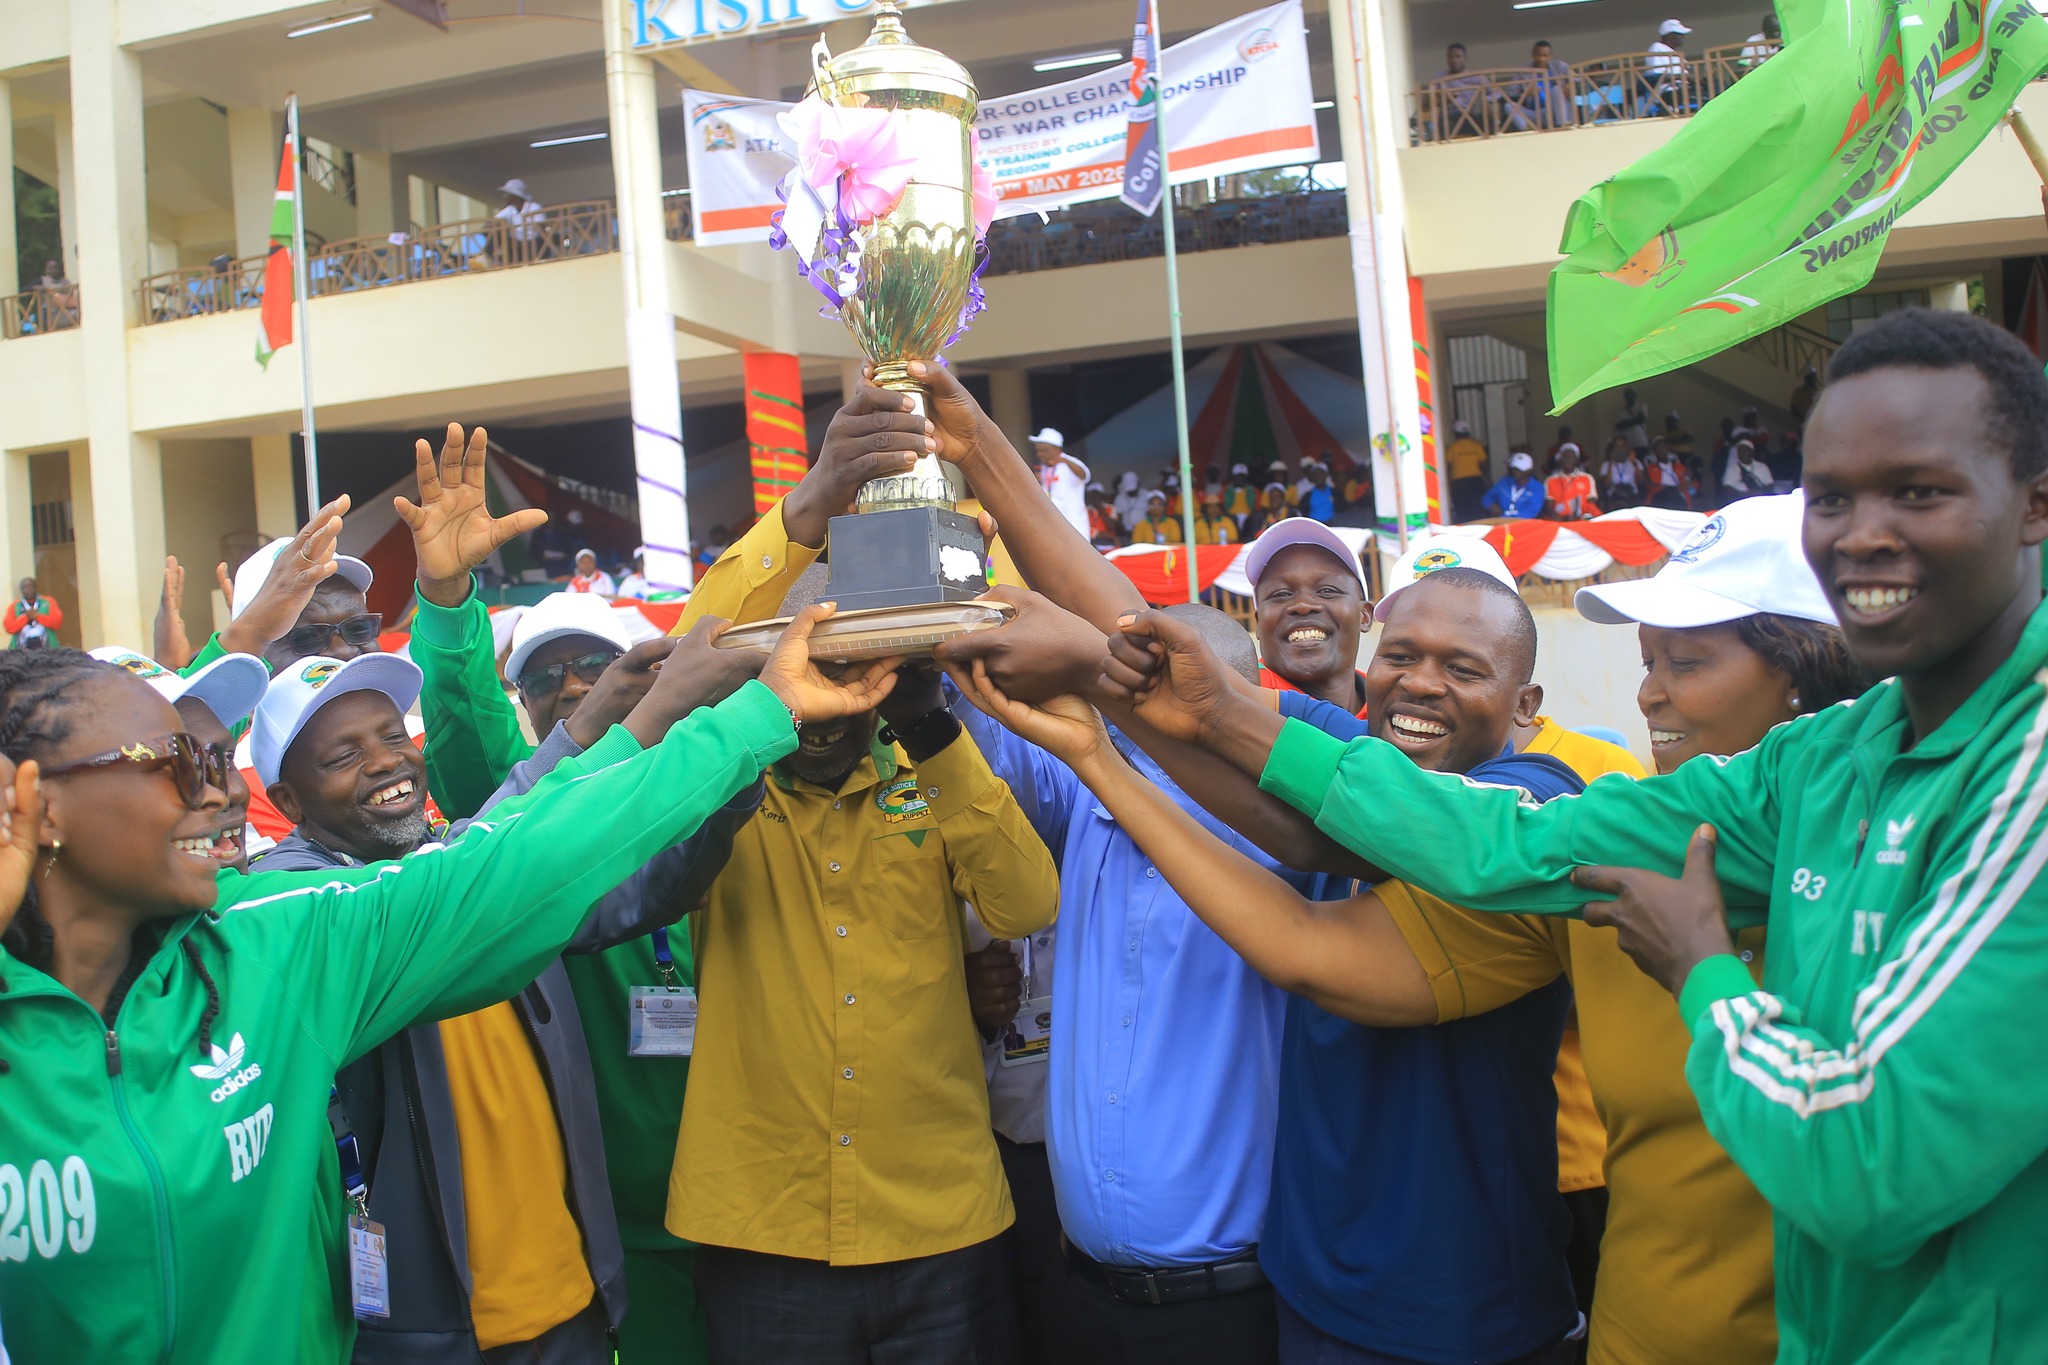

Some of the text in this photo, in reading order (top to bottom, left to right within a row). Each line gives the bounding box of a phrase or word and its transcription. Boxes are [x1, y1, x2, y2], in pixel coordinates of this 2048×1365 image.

[976, 79, 1131, 122] R-COLLEGIAT
[978, 125, 1007, 140] OF
[1014, 115, 1065, 135] WAR
[994, 147, 1062, 166] TRAINING
[996, 162, 1050, 178] REGION
[1026, 174, 1072, 195] MAY
[902, 809, 929, 820] KUPPET
[1791, 867, 1827, 901] 93
[210, 1062, 262, 1103] adidas
[0, 1154, 97, 1263] 209
